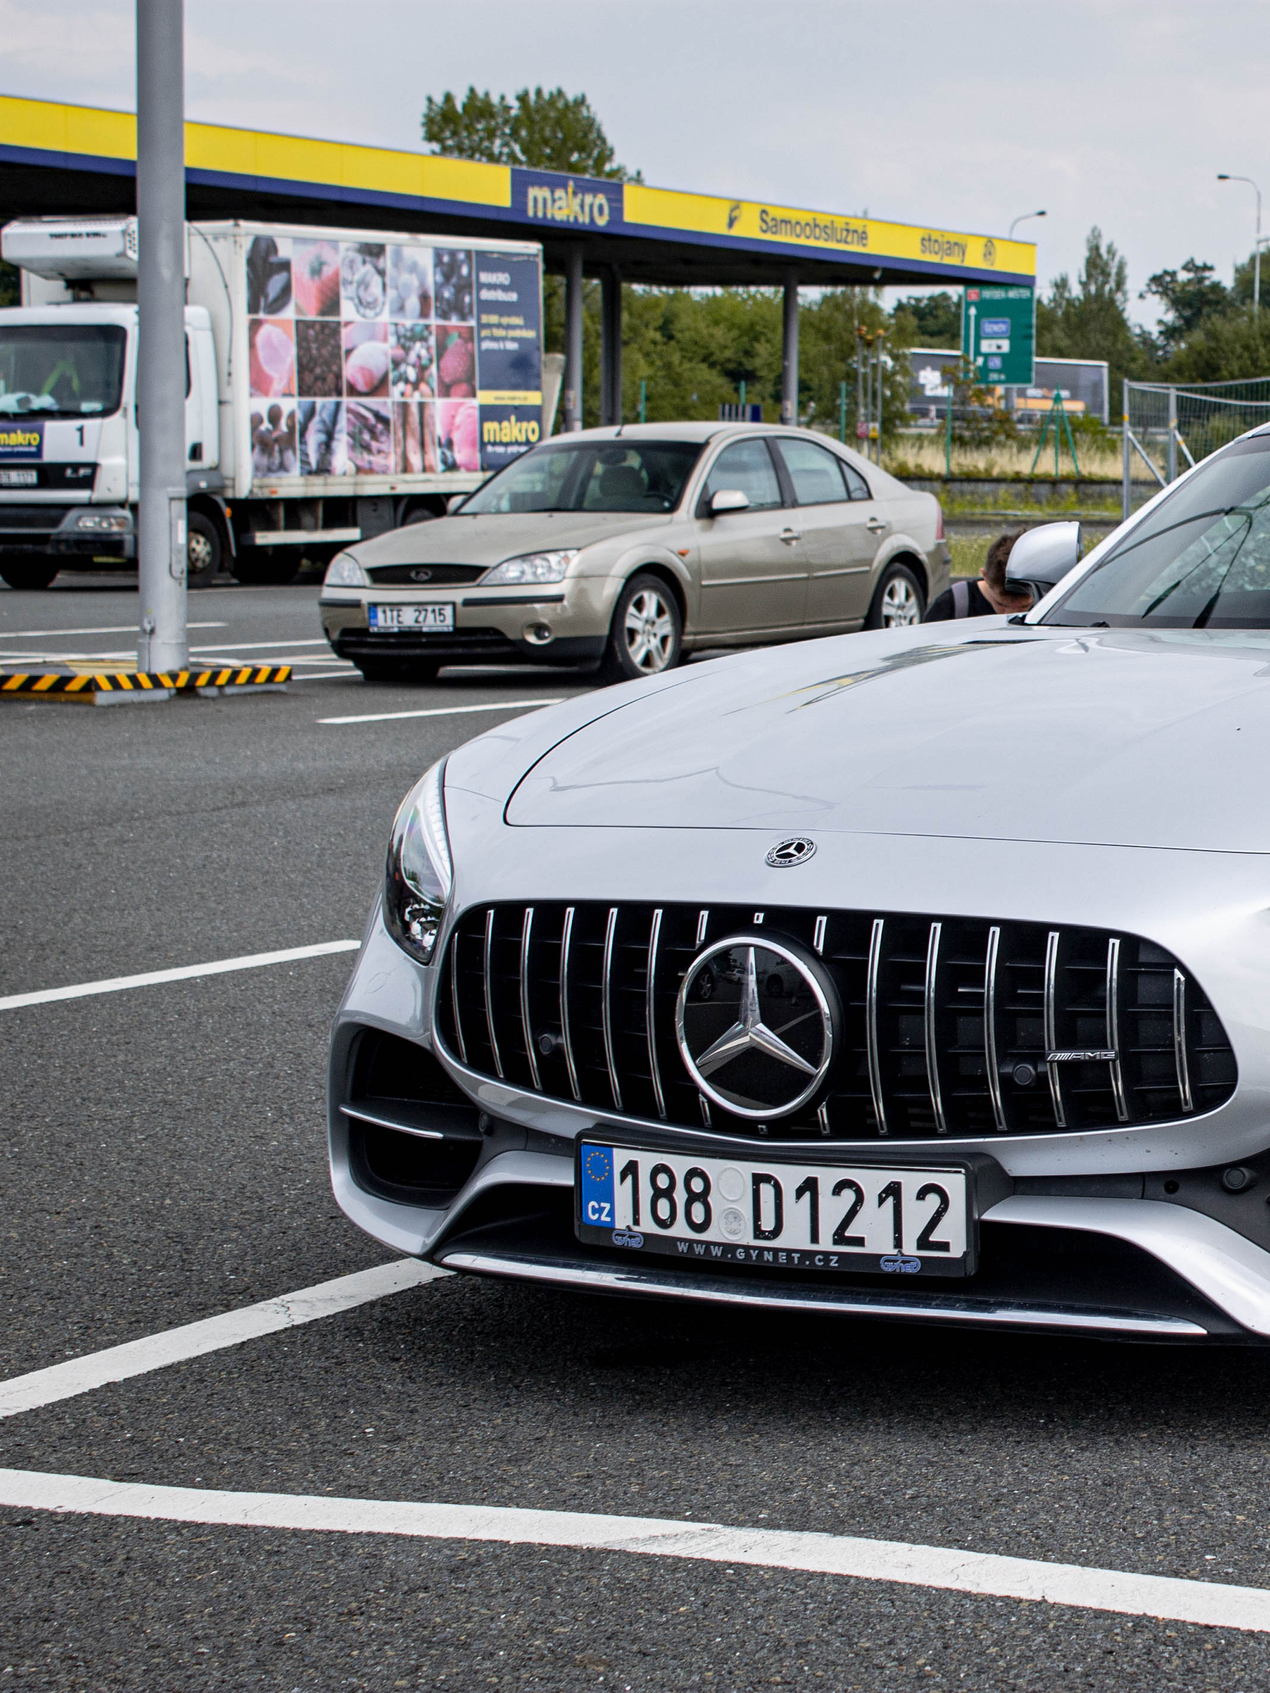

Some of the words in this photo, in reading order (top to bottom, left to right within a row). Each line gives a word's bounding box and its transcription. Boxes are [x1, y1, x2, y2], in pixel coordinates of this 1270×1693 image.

[527, 180, 609, 226] makro
[760, 208, 868, 247] Samoobslužné
[920, 234, 968, 263] stojany
[76, 425, 84, 447] 1
[483, 414, 539, 442] makro
[382, 608, 403, 624] 1TE
[414, 608, 446, 623] 2715
[587, 1200, 612, 1222] CZ
[619, 1159, 713, 1234] 188
[752, 1171, 951, 1252] D1212
[677, 1241, 840, 1268] WWW.GYNET.CZ
